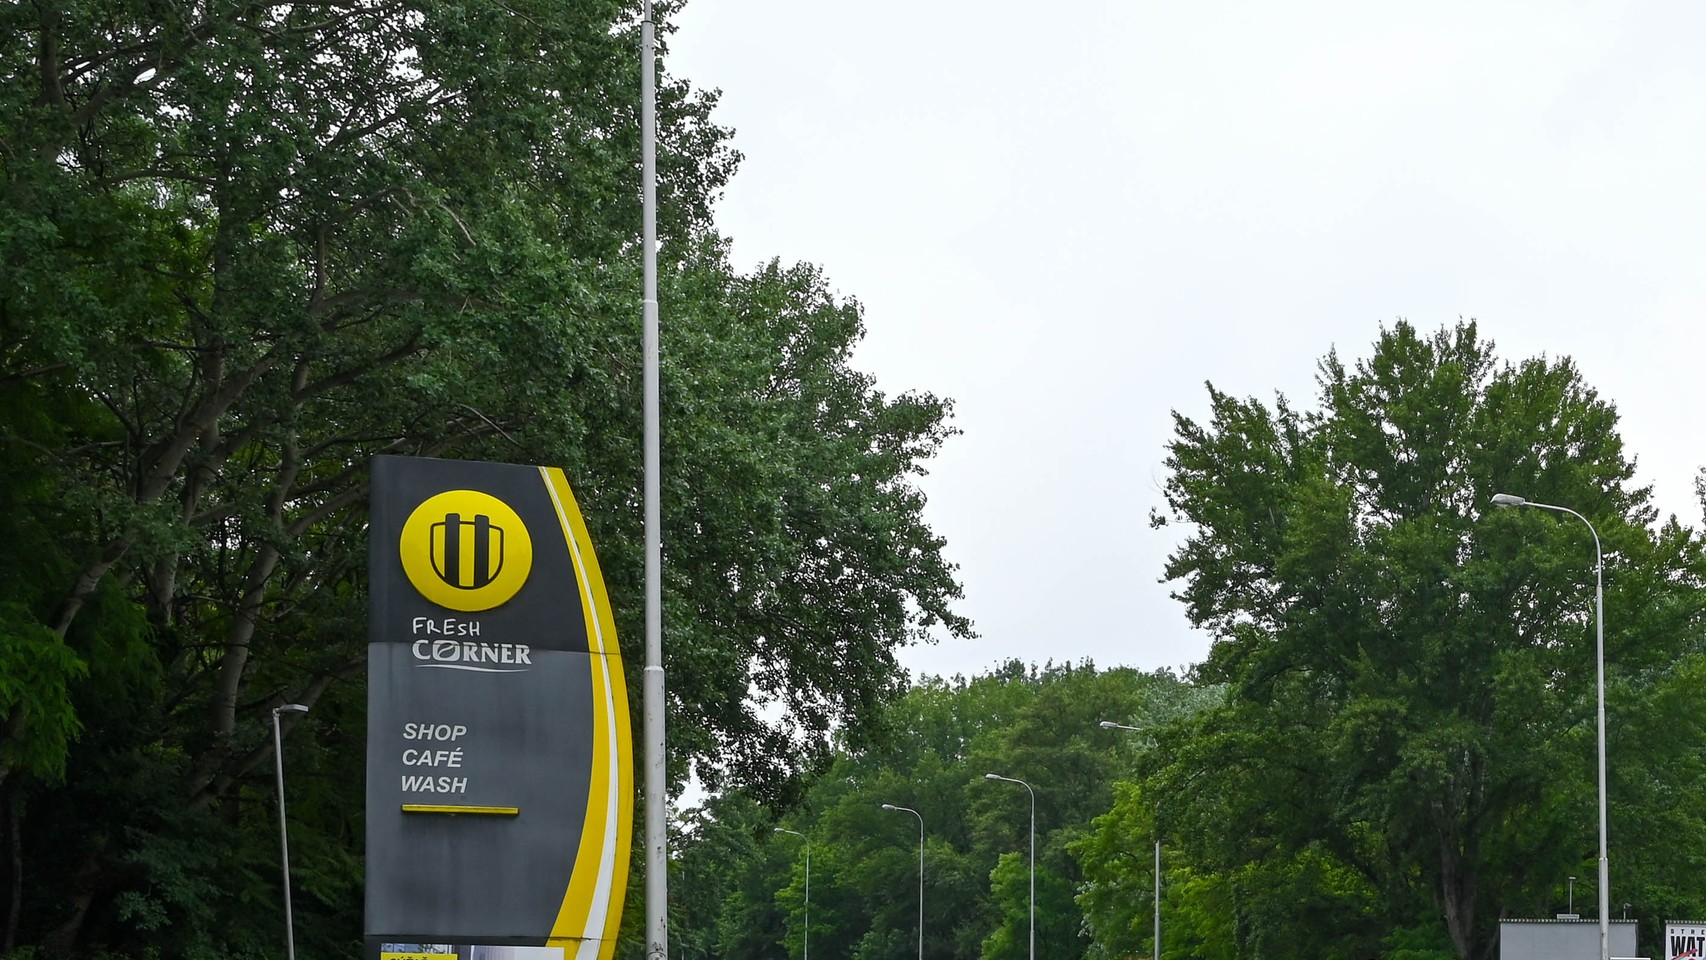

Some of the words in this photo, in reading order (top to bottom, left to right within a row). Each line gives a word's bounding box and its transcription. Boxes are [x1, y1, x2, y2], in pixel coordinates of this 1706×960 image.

[412, 617, 480, 636] FRESH
[412, 640, 532, 664] CORNER
[403, 723, 467, 741] SHOP
[402, 747, 464, 767] CAFÉ
[401, 775, 468, 793] WASH
